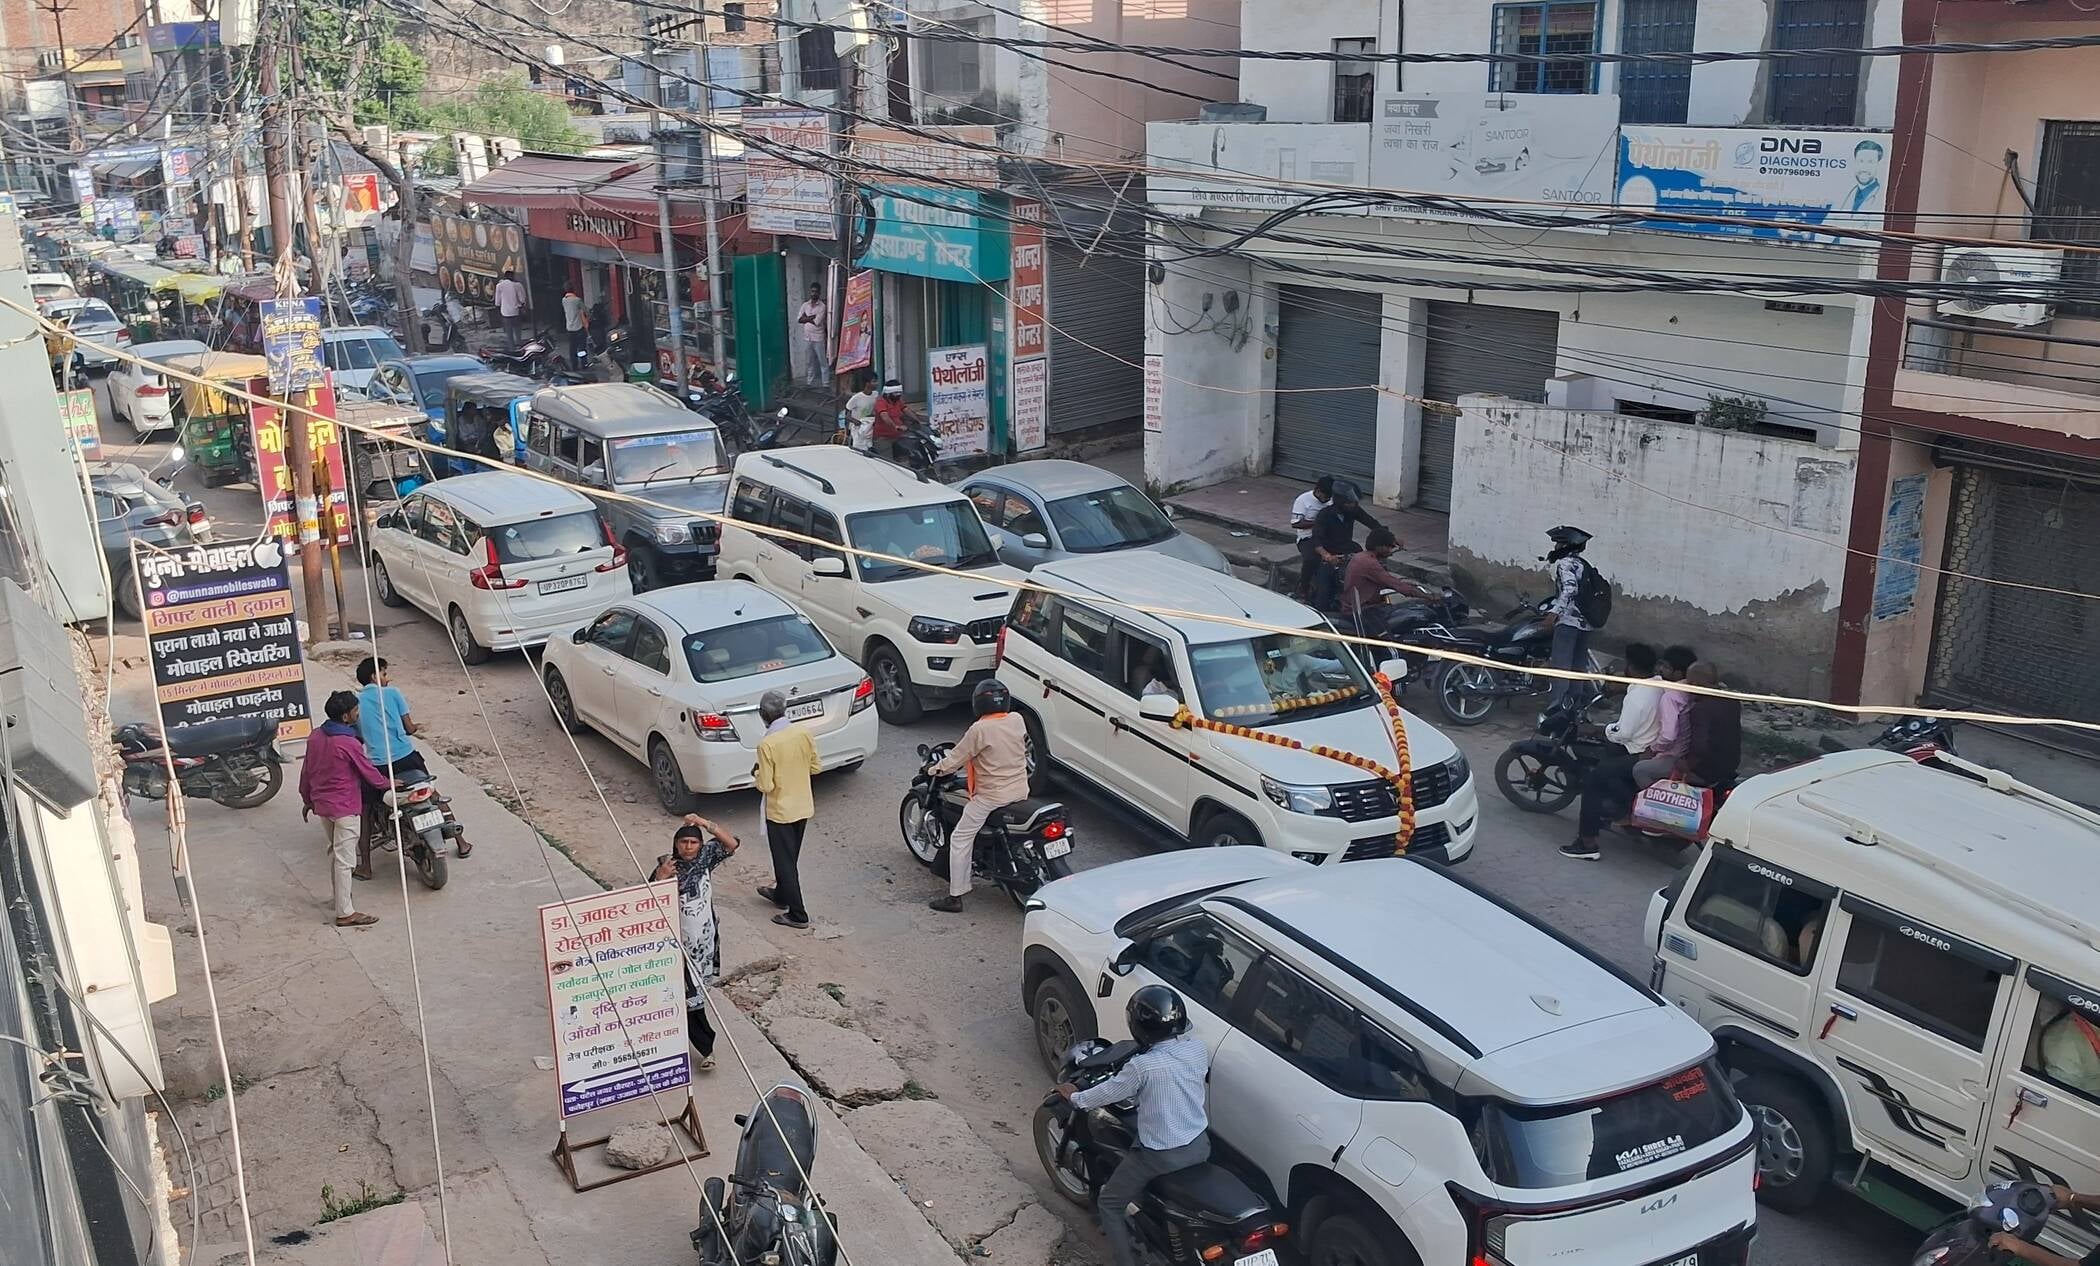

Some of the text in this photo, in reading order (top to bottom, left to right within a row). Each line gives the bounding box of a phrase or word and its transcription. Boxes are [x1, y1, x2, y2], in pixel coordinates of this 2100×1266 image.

[1405, 121, 1432, 136] निखरी
[1485, 128, 1529, 142] SANTOOR
[1406, 138, 1418, 150] का
[1422, 139, 1440, 152] राज
[1760, 155, 1847, 169] DIAGNOSTICS
[1768, 167, 1821, 177] 7007960963
[1543, 188, 1602, 203] SANTOOR
[931, 357, 985, 386] पैथोलॉजी
[188, 544, 254, 573] मोबाइल
[167, 576, 278, 602] @munnamobileswala
[151, 596, 286, 627] गिफ्ट वाली दुकान
[154, 618, 293, 658] पुराना लाओ नया ले जाओ
[166, 642, 291, 677] मोबाइल रिपेयरिंग
[186, 696, 234, 716] मोबाइल
[1645, 788, 1698, 810] BROTHERS
[1760, 866, 1793, 886] BOLERO
[578, 902, 630, 927] जवाहर
[635, 893, 671, 913] लाल
[556, 916, 671, 953] रोहतगी स्मारक
[1914, 930, 1951, 951] BOLERO
[596, 940, 655, 963] चिकित्सालय
[571, 988, 605, 1002] कानपुर
[630, 973, 666, 990] संचालित
[621, 994, 648, 1009] केन्द्र
[604, 1019, 621, 1033] का
[583, 1043, 615, 1057] परीक्षक
[1615, 1147, 1638, 1161] KIA
[1641, 1193, 1677, 1215] KIA
